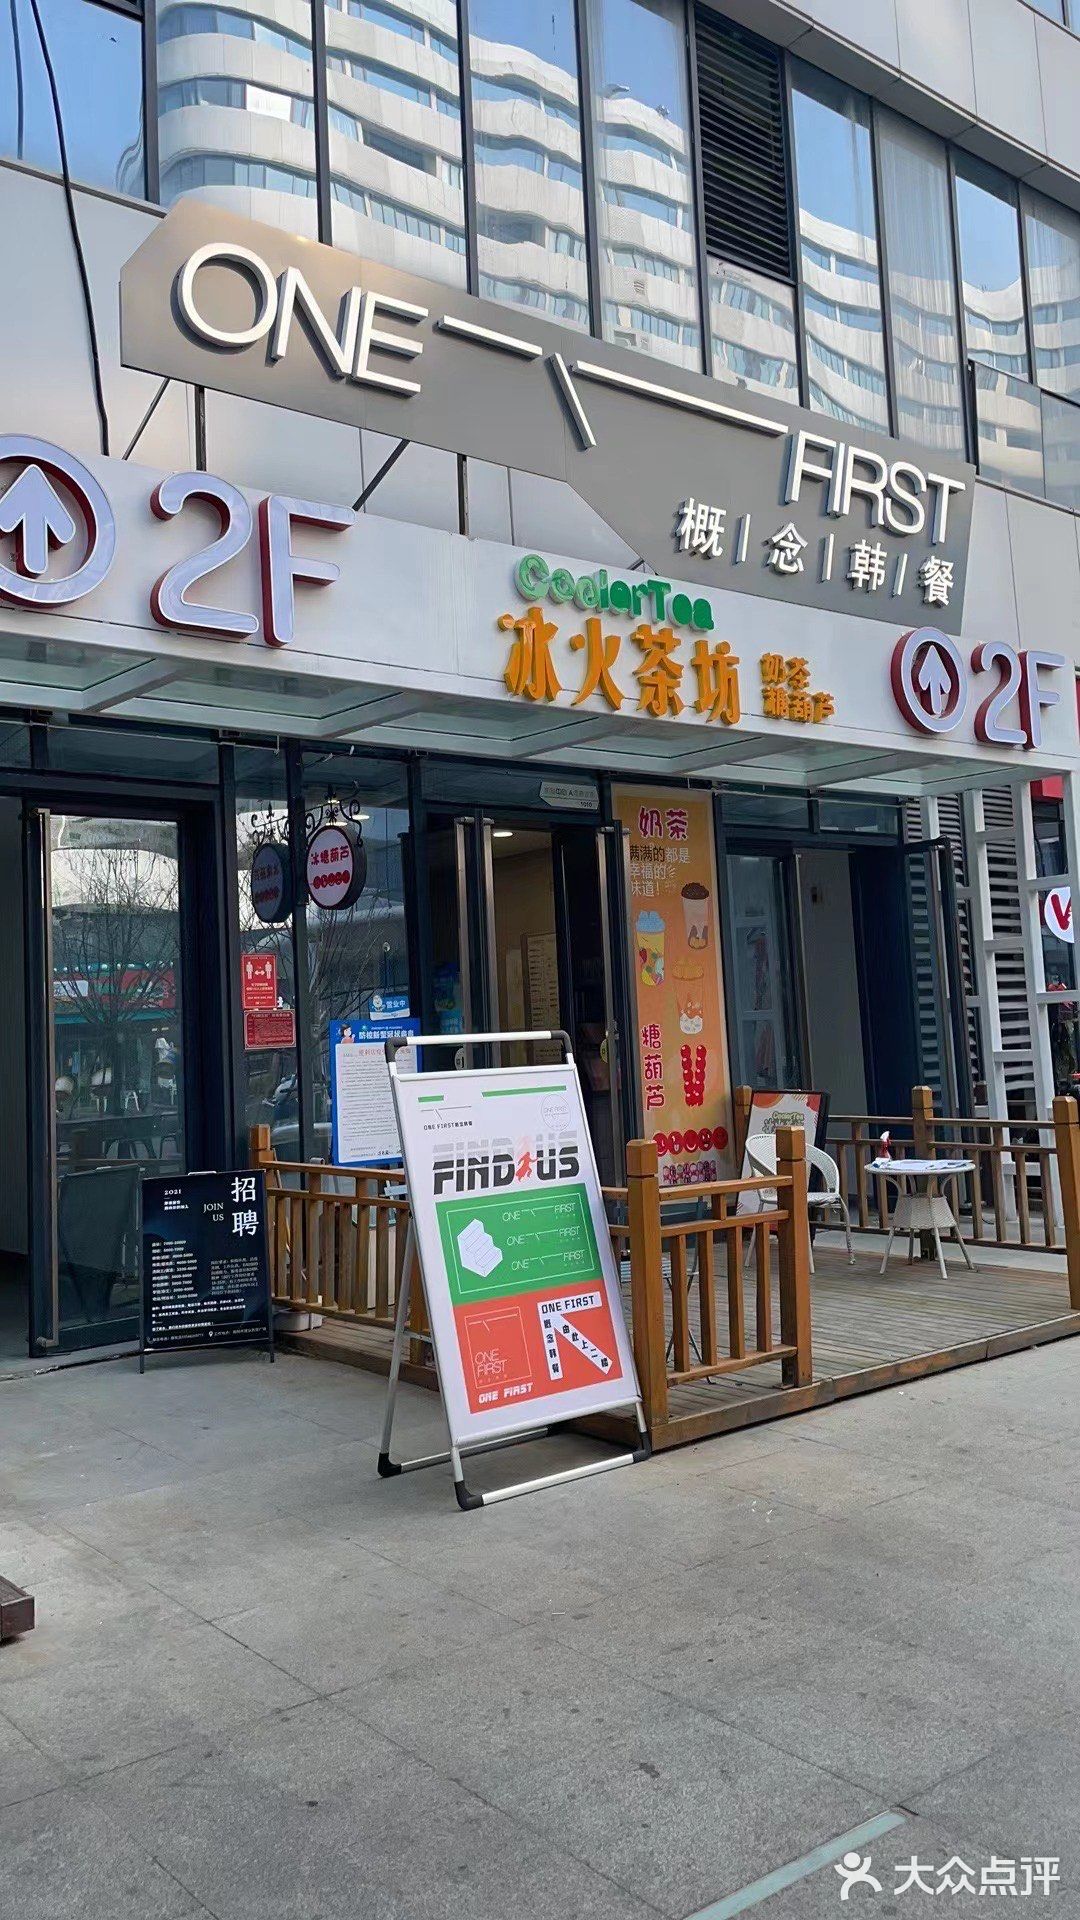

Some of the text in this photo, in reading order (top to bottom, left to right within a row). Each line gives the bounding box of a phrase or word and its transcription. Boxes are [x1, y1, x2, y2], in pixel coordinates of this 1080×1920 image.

[172, 242, 966, 547] ONE FIRST
[150, 471, 356, 648] 2F
[515, 553, 715, 632] CoolerTea
[497, 606, 741, 726] 冰火茶坊
[760, 652, 810, 689] 奶茶
[763, 686, 837, 724] 糖葫芦
[973, 641, 1067, 751] 2F
[639, 805, 690, 841] 奶茶
[629, 845, 690, 864] 满满的都是
[630, 863, 667, 881] 幸福的
[642, 1023, 664, 1110] 糖葫芦
[432, 1145, 580, 1195] FIND US
[203, 1202, 225, 1214] JOIN
[212, 1213, 225, 1222] US
[231, 1176, 260, 1237] 招聘
[502, 1210, 521, 1222] ONE
[506, 1234, 525, 1246] ONE
[511, 1258, 530, 1271] ONE
[541, 1295, 595, 1315] ONE FIRST
[475, 1348, 500, 1365] ONE
[477, 1359, 508, 1379] FIRST
[478, 1382, 534, 1405] ONE FIRST
